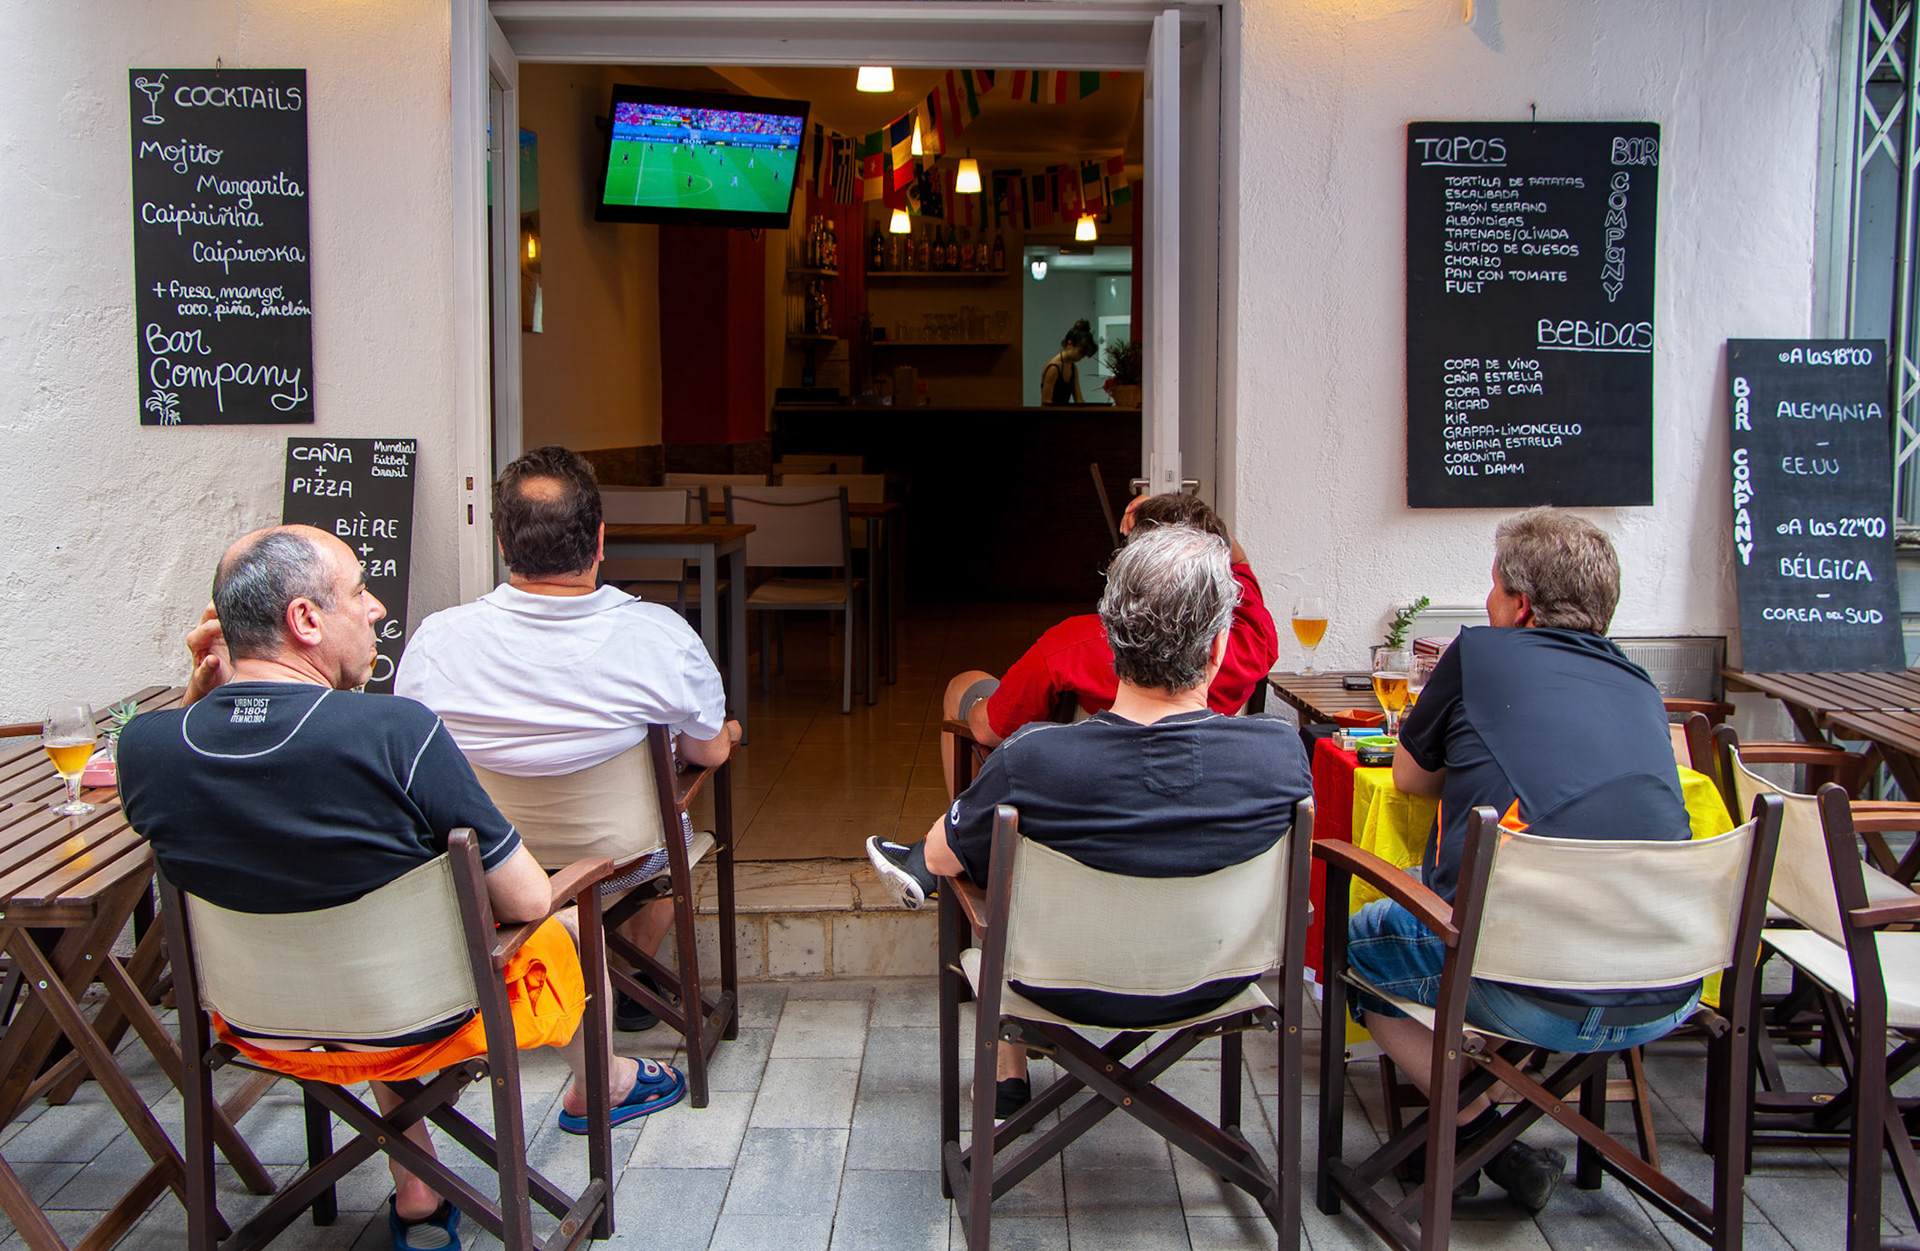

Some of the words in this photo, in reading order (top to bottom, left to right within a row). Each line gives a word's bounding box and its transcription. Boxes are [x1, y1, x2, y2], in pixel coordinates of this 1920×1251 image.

[139, 138, 223, 174] Mojito
[1508, 177, 1524, 187] DE
[1528, 177, 1585, 188] PATATAS
[197, 171, 304, 209] Margarita
[1446, 199, 1487, 213] JAMÓN
[1491, 202, 1547, 213] SERRANO
[193, 239, 305, 274] Caipiroska
[1503, 244, 1519, 254] DE
[1522, 244, 1580, 257] QUESOS
[1445, 268, 1472, 279] PAN
[1477, 270, 1504, 281] CON
[1508, 271, 1568, 282] TOMATE
[153, 282, 167, 298] +
[1446, 281, 1485, 294] FUET
[261, 300, 311, 317] melón
[145, 323, 212, 355] Bar
[1806, 348, 1833, 366] las
[1444, 359, 1480, 370] COPA
[1485, 359, 1500, 369] DE
[150, 357, 309, 412] Company
[1443, 370, 1478, 385] CAÑA
[1485, 371, 1543, 383] ESTRELLA
[1445, 387, 1480, 397] COPA
[1486, 385, 1502, 395] DE
[1507, 384, 1544, 395] CAVA
[1733, 377, 1751, 431] BAR
[374, 441, 416, 454] Mundial
[1505, 436, 1563, 449] ESTRELLA
[292, 443, 353, 464] CAÑA
[373, 454, 409, 465] Fútbol
[315, 465, 328, 476] +
[371, 466, 408, 478] Brasil
[1445, 465, 1478, 476] VOLL
[1485, 463, 1525, 475] DAMM
[1781, 456, 1840, 475] EE.UU
[1733, 448, 1754, 566] COMPANY
[1809, 518, 1837, 537] las
[358, 543, 374, 557] +
[1762, 607, 1822, 623] COREA
[1826, 611, 1844, 621] DEL
[1845, 607, 1884, 625] SUD
[234, 698, 252, 707] URBN
[253, 698, 270, 707] DIST
[233, 707, 268, 715] B-1804
[230, 715, 244, 723] ITEM
